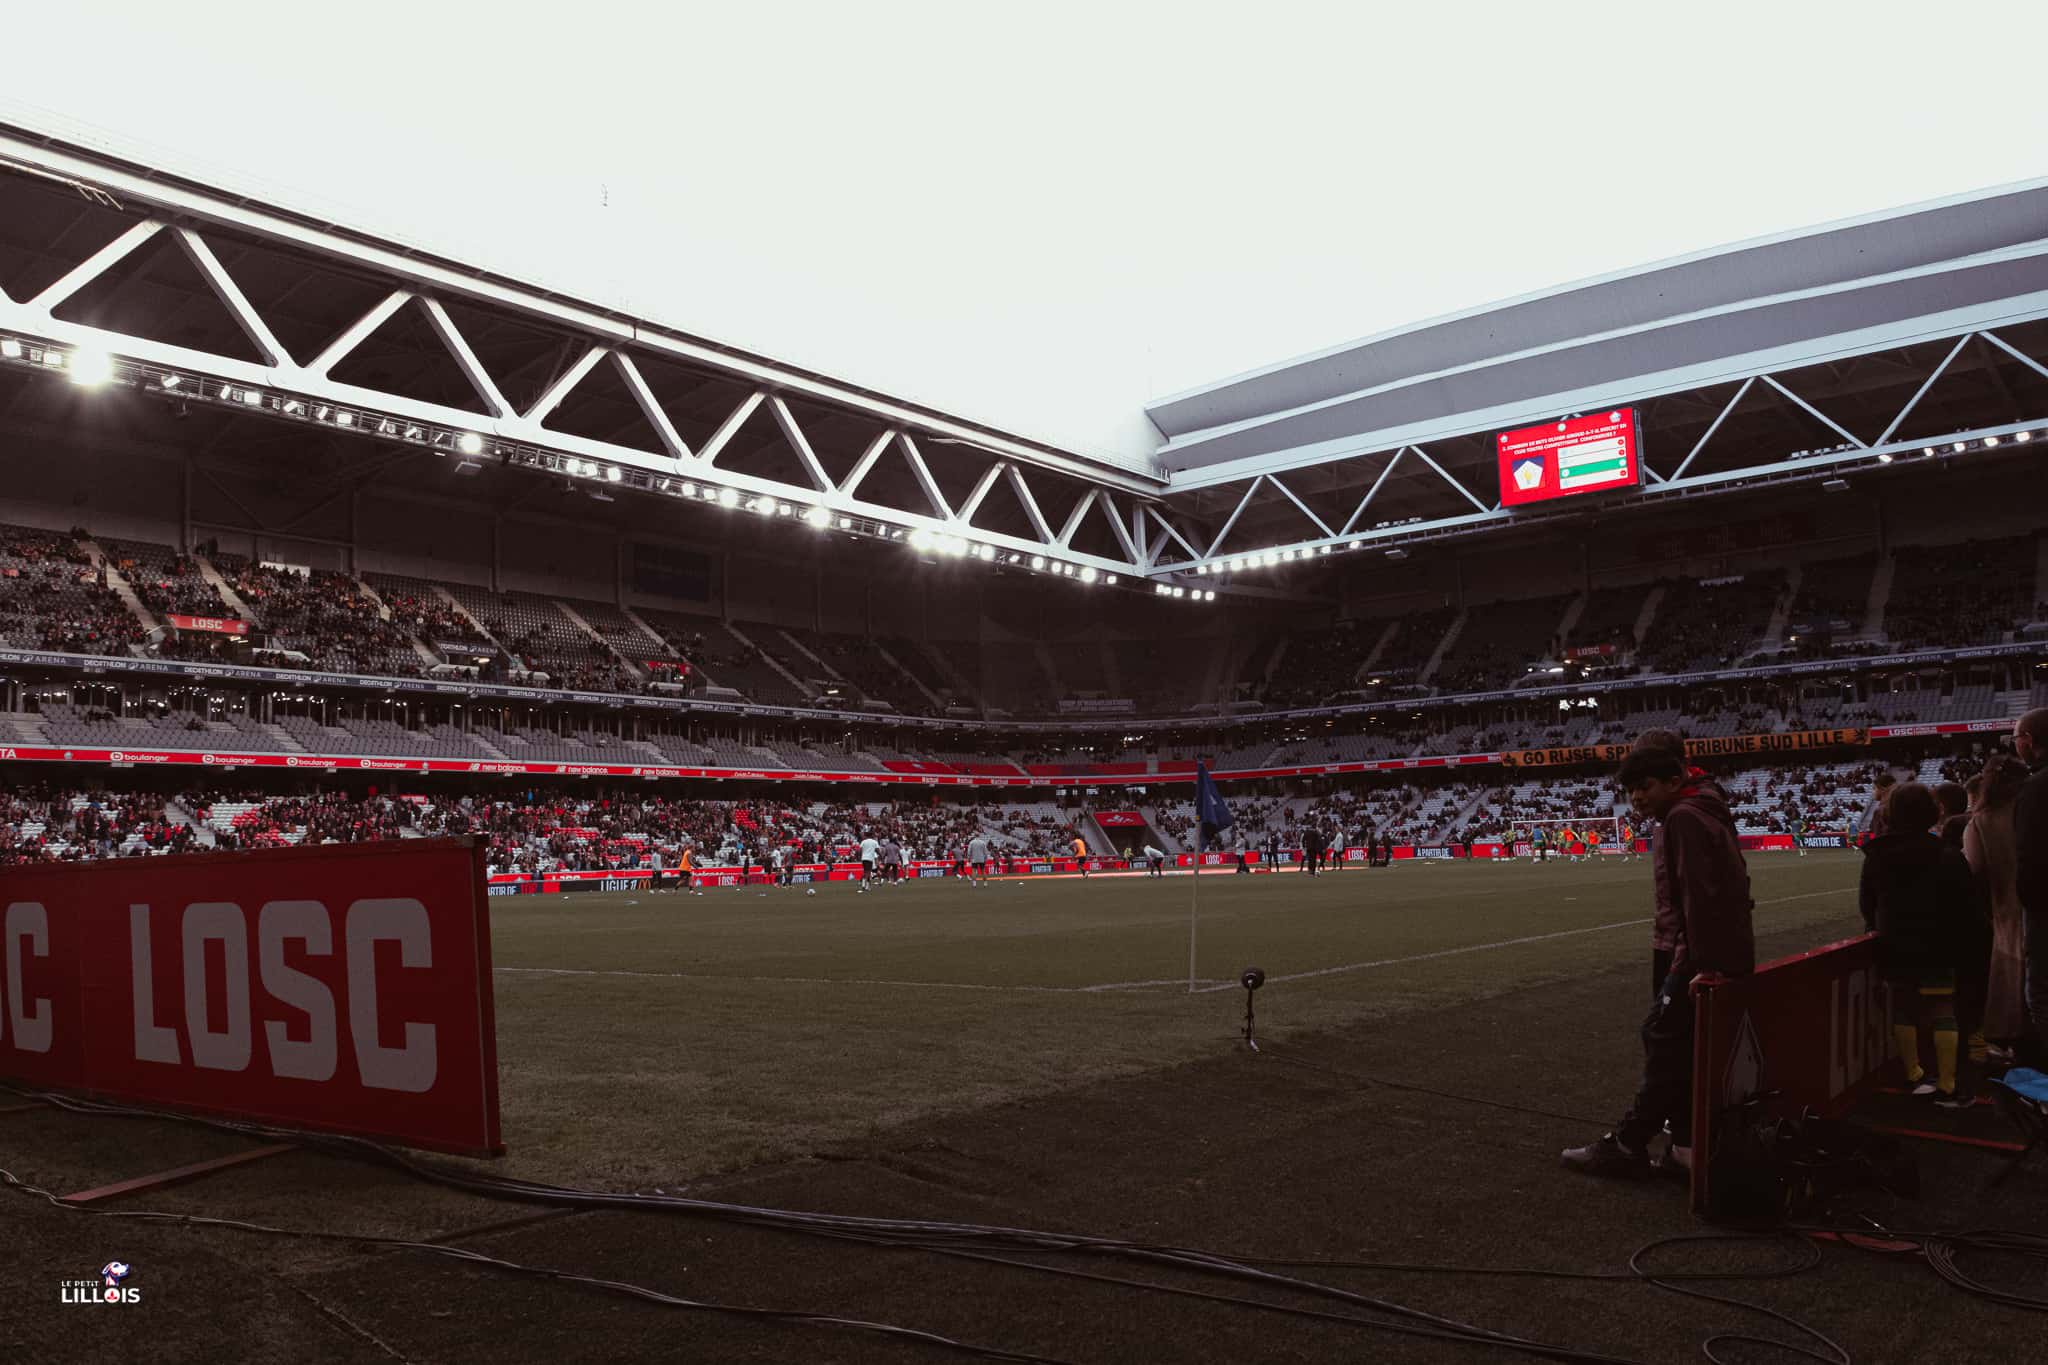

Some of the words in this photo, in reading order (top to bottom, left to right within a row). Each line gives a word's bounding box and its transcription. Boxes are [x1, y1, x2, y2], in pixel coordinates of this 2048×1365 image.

[192, 619, 223, 629] LOSC
[32, 656, 66, 664] ARENA
[84, 659, 126, 669] DECATHLON
[138, 663, 168, 672] ARENA
[184, 666, 224, 674] DECATHLON
[1968, 722, 1992, 731] LOSC
[1888, 728, 1914, 736] LOSC
[1686, 737, 1754, 754] TRIBUNE
[1760, 735, 1792, 750] SUD
[1798, 730, 1844, 748] LILLE
[124, 753, 170, 764] boulanger
[215, 756, 256, 766] boulanger
[1523, 752, 1544, 765] GO
[1550, 747, 1602, 764] RIJSEL
[298, 759, 336, 768] boulanger
[1804, 838, 1830, 847] PARTIR
[1830, 837, 1840, 846] DE
[600, 880, 629, 892] LIGUE
[129, 897, 438, 1093] LOSC
